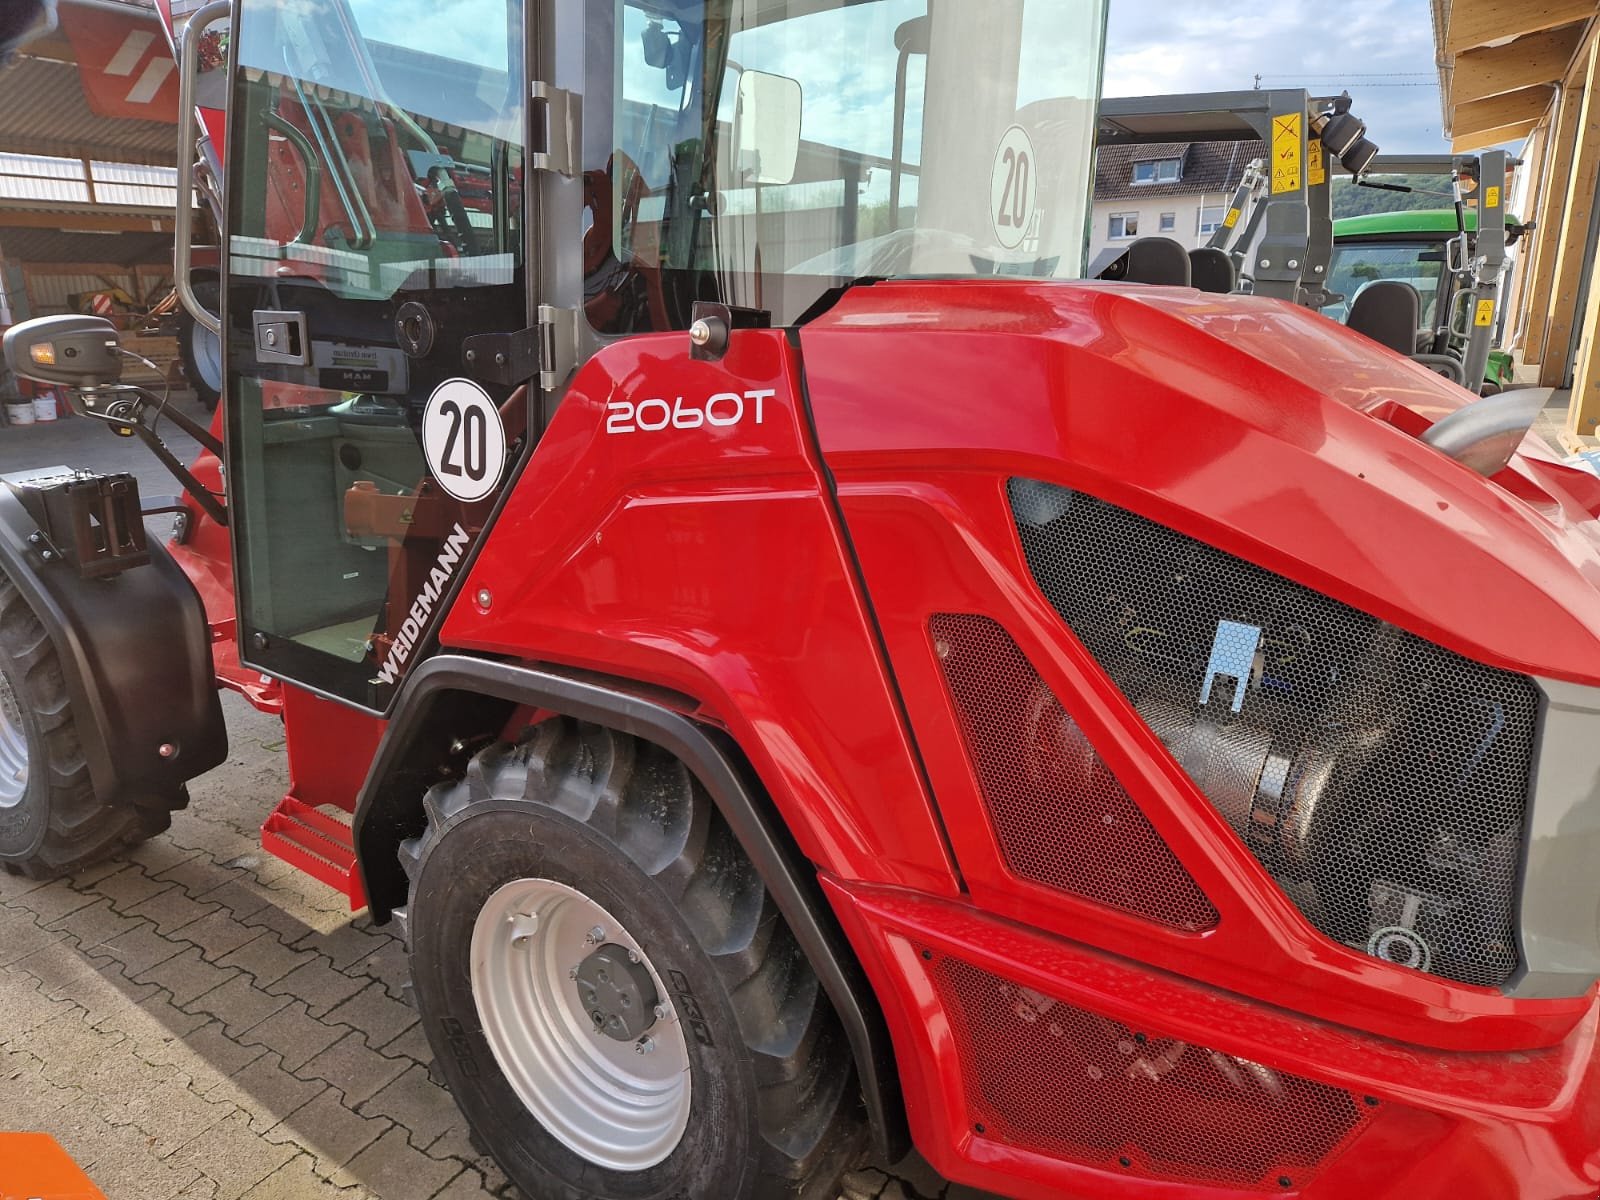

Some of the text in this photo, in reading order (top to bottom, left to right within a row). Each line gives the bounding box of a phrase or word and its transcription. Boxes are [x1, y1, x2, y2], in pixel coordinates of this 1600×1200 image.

[998, 146, 1029, 228] 20
[439, 399, 487, 481] 20
[606, 389, 776, 434] 2060T
[377, 522, 470, 685] WEIDEMANN
